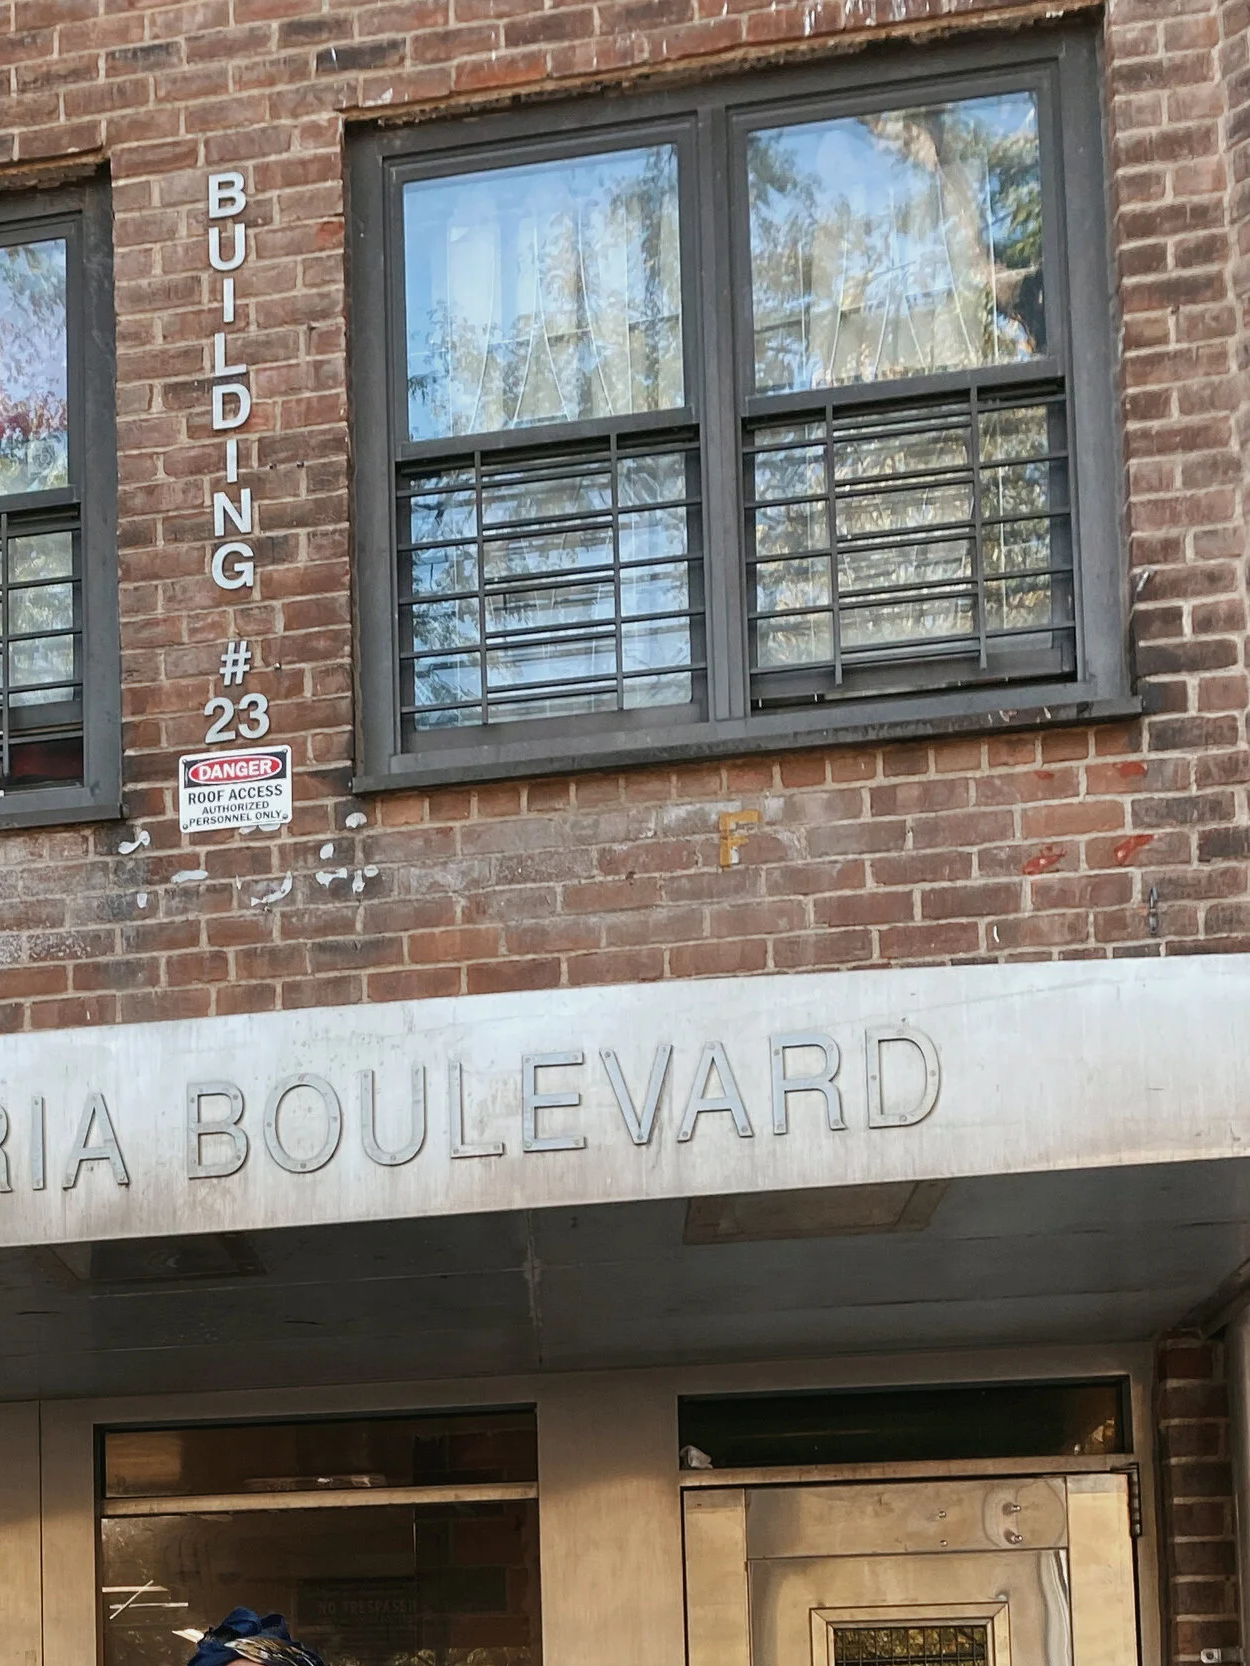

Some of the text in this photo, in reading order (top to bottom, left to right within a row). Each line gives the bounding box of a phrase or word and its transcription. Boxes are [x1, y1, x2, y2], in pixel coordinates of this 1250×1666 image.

[202, 172, 271, 745] BUILDING # 23
[198, 759, 272, 781] DANGER
[188, 784, 283, 806] ROOF ACCESS
[189, 810, 282, 827] PERSONNEL ONLY
[202, 801, 269, 815] AUTHORIZED
[186, 1025, 941, 1180] BOULEVARD
